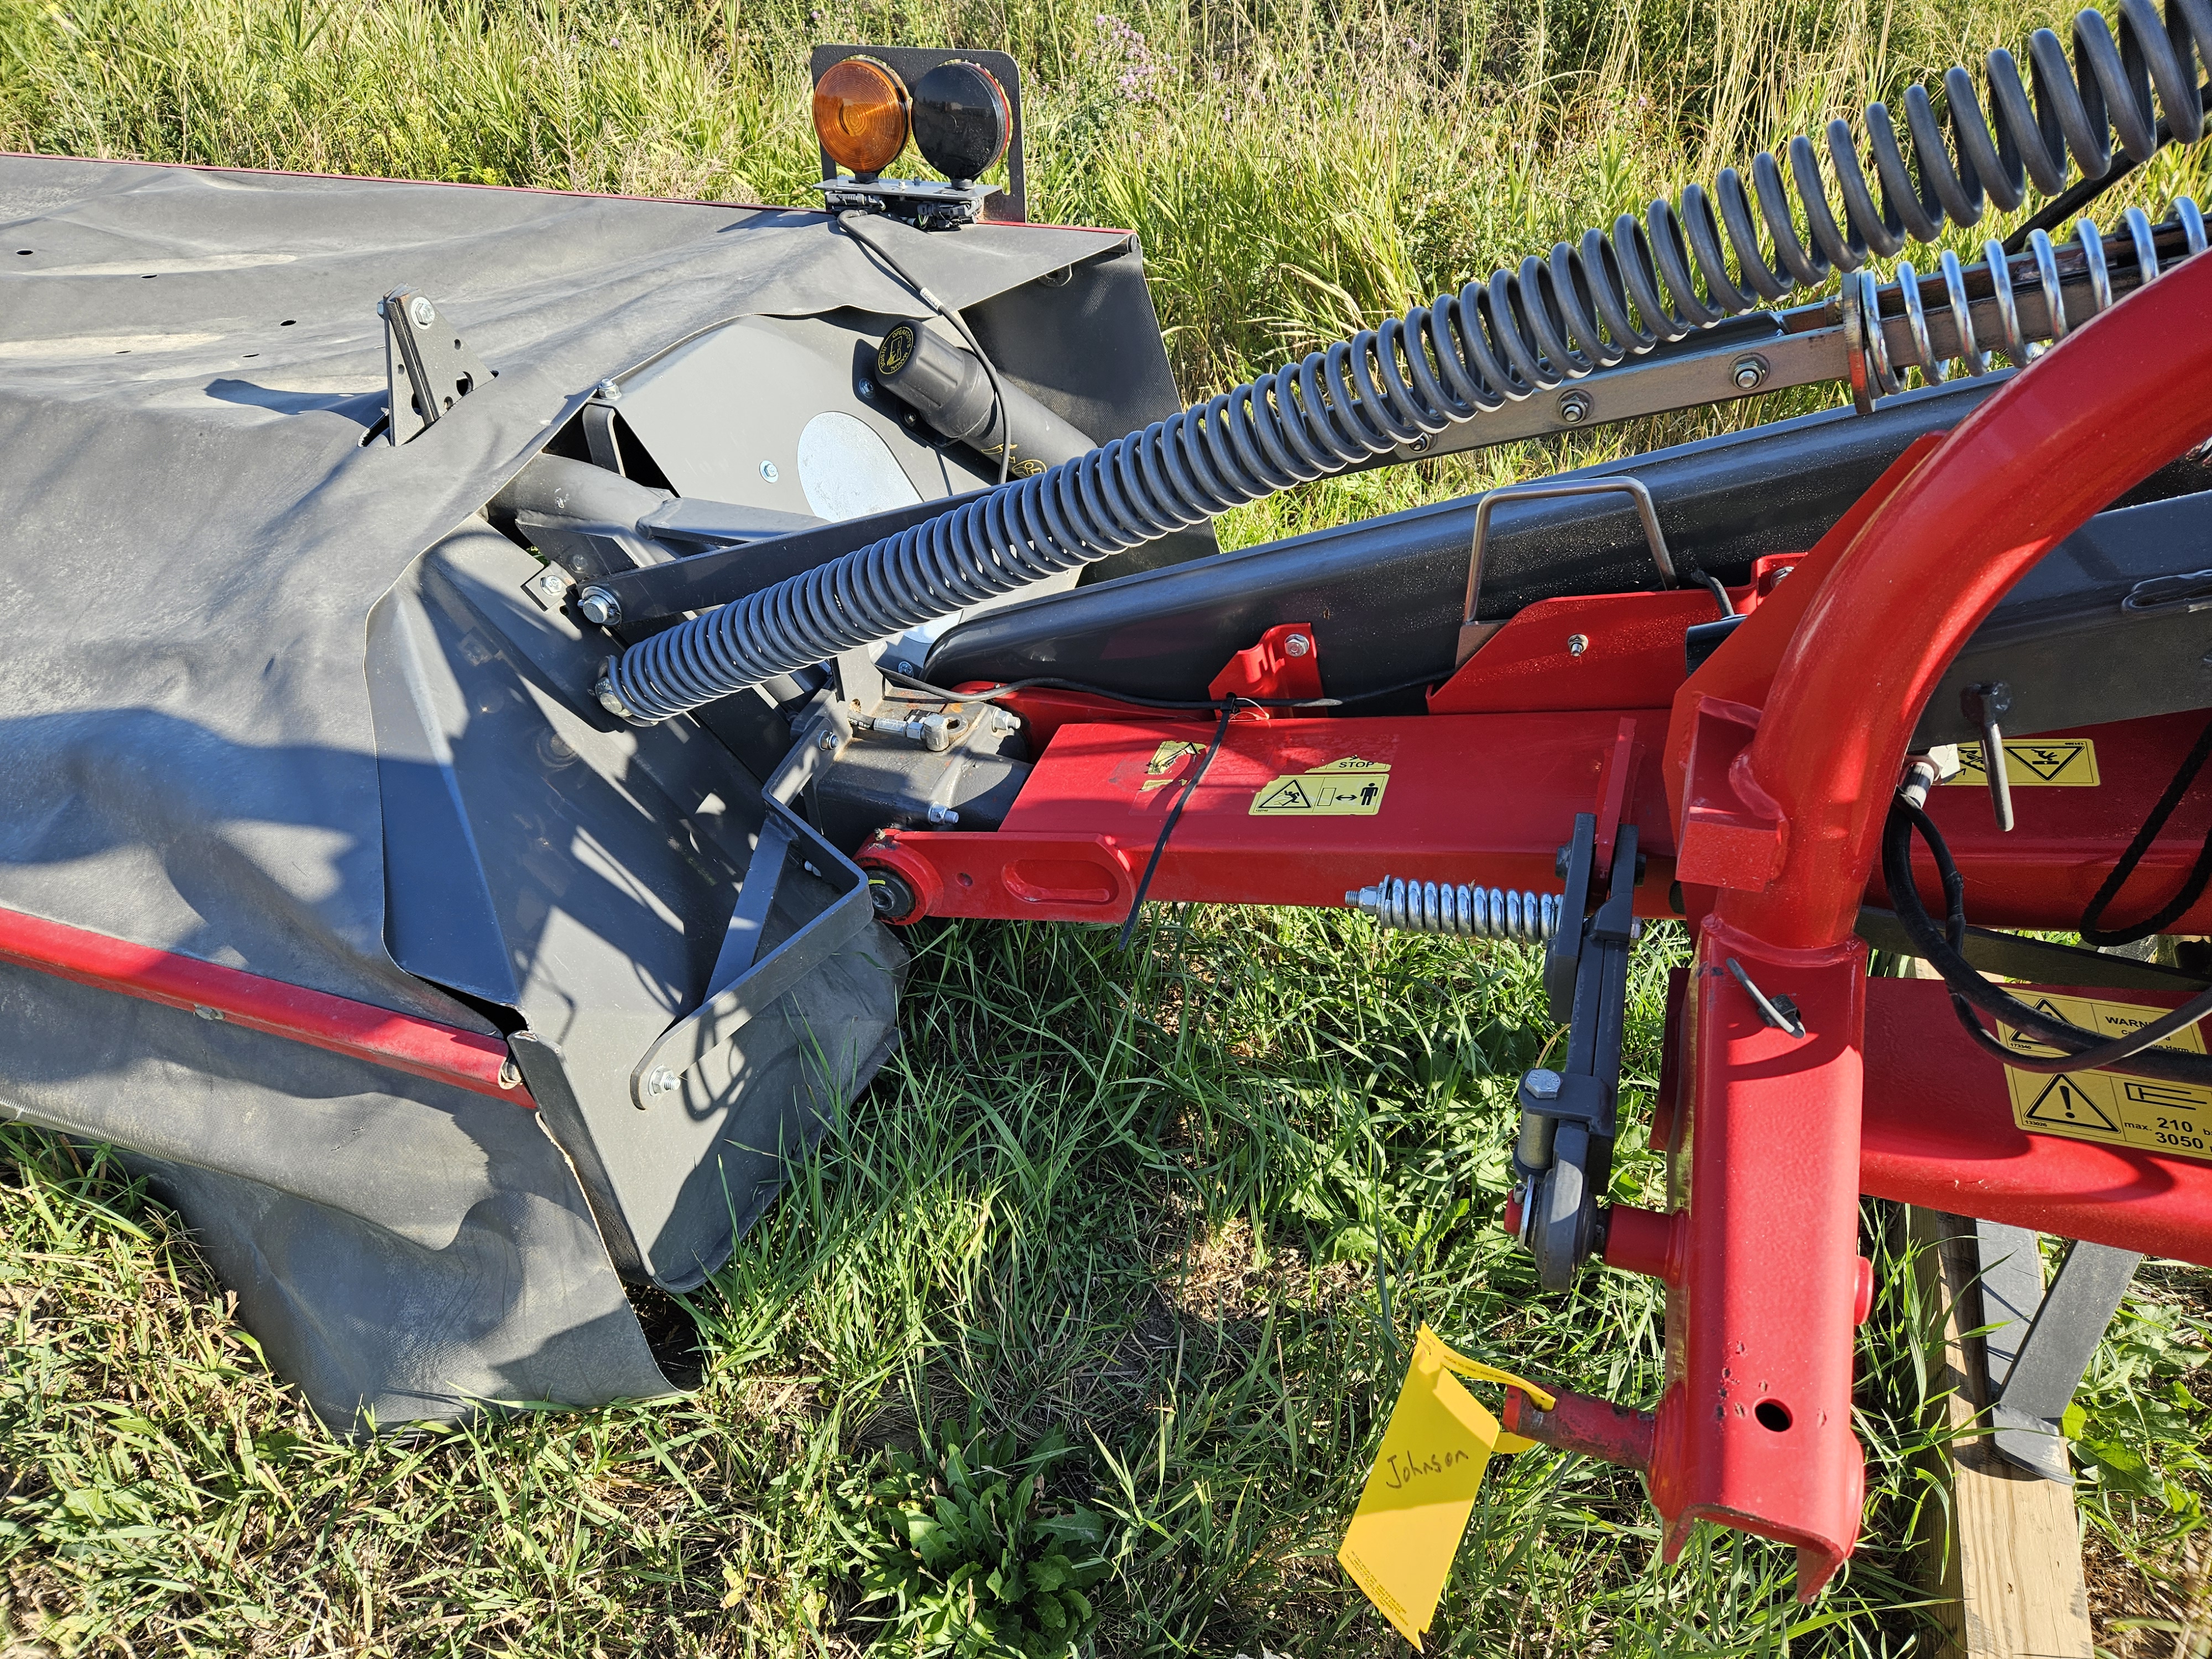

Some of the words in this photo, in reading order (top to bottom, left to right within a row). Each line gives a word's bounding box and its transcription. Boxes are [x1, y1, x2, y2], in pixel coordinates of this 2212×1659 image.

[922, 290, 939, 307] 166243
[890, 352, 908, 372] MANUAL
[2105, 1016, 2153, 1028] WARN
[2124, 1122, 2152, 1131] max.
[2157, 1117, 2193, 1133] 210
[2154, 1131, 2204, 1149] 3050
[1386, 1450, 1469, 1489] Johnson
